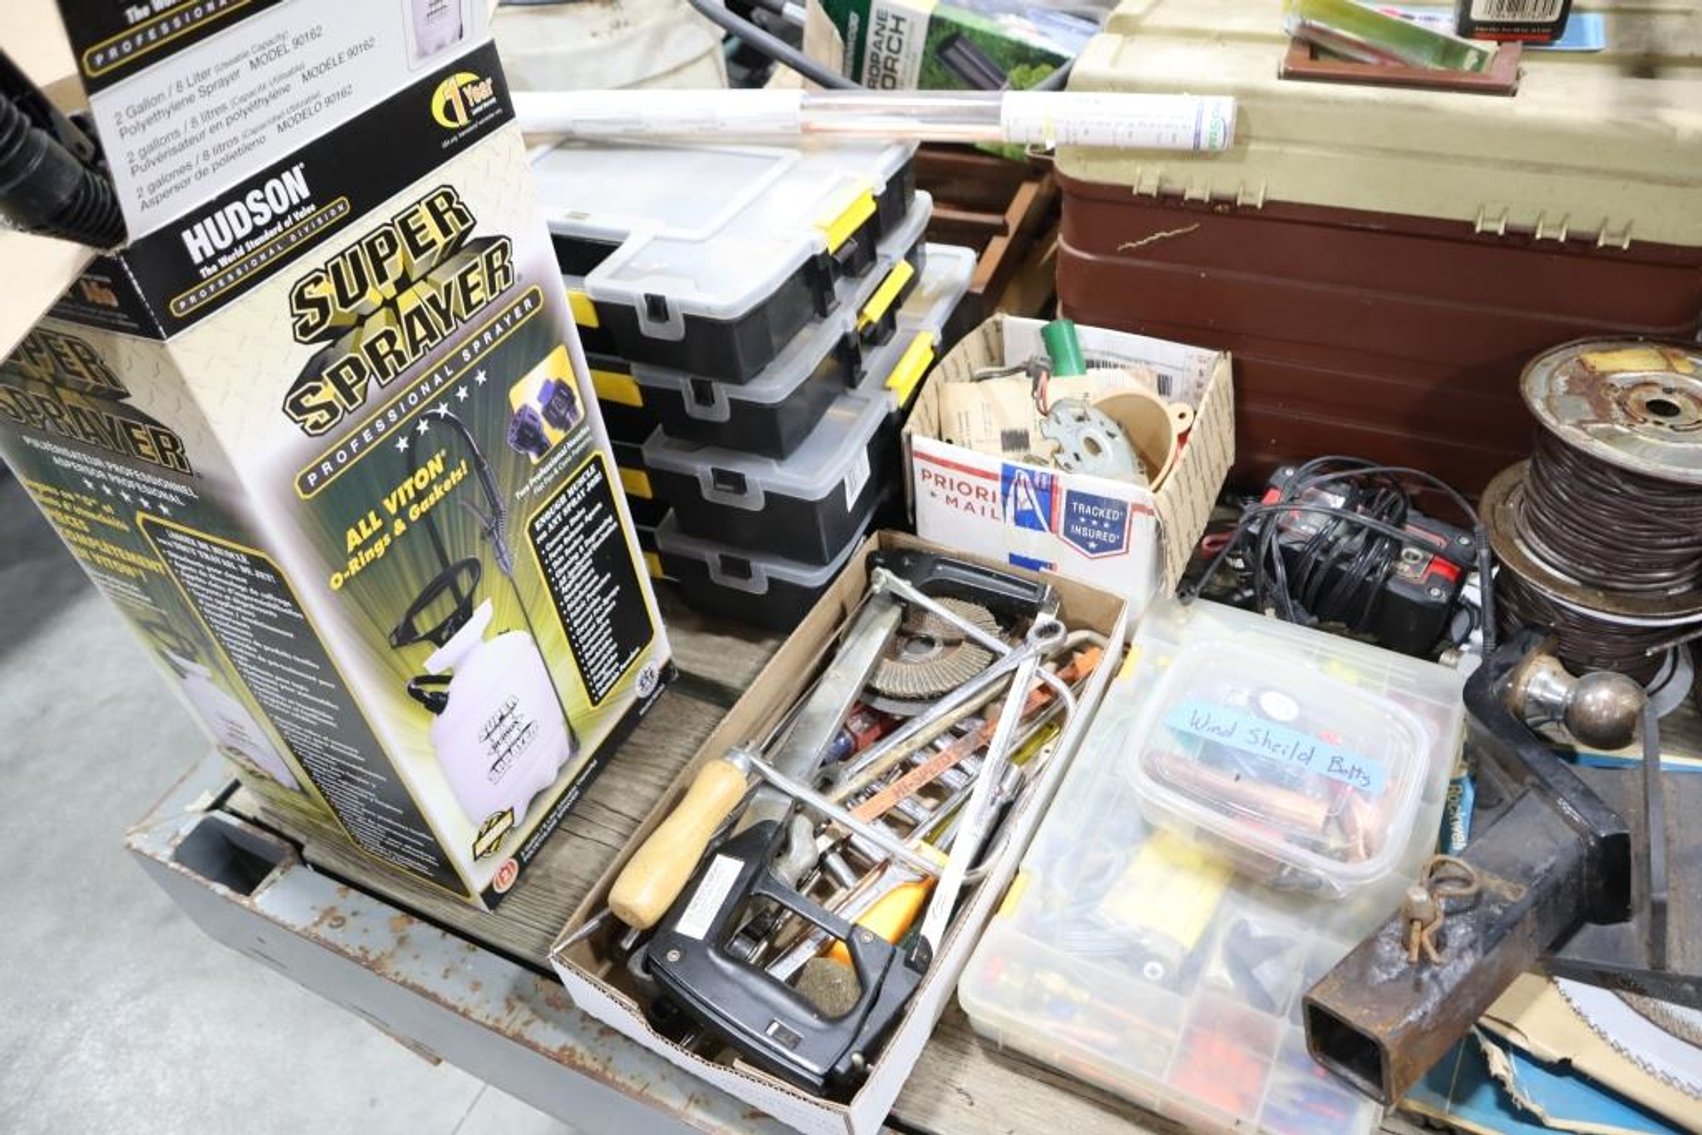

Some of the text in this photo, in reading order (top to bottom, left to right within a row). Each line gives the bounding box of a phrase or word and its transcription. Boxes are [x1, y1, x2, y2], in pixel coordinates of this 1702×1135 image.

[95, 0, 237, 66] PROFESSIONA
[125, 4, 150, 24] The
[119, 24, 324, 138] Polyethylene Sprayer MODEL 90162
[867, 8, 889, 90] ROPANE
[881, 14, 907, 91] ORCH
[114, 110, 122, 125] 2
[125, 92, 165, 119] Gallon
[186, 68, 213, 89] Liter
[462, 77, 494, 107] Year
[126, 150, 135, 164] 2
[138, 130, 180, 161] gallons
[200, 103, 229, 121] litres
[140, 178, 192, 212] Aspersor
[194, 166, 209, 181] de
[277, 101, 323, 134] MODELO
[208, 120, 224, 135] en
[136, 186, 145, 199] 2
[147, 163, 194, 196] galones
[212, 136, 240, 157] litros
[181, 165, 311, 265] HUDSON
[199, 203, 317, 280] The World Standard of Value
[179, 243, 284, 309] PROFESSIONAL
[290, 203, 346, 242] DIVISION
[290, 185, 476, 344] SUPER
[282, 238, 515, 436] SPRAYER
[307, 298, 534, 487] PROFESSIONAL SPRAYER
[347, 453, 444, 555] ALL VITON
[534, 493, 569, 532] ENOUGH
[920, 468, 997, 503] PRIORI
[945, 495, 1002, 521] MAIL
[1072, 501, 1120, 521] TRACKED
[330, 533, 392, 591] O-Rings
[393, 518, 407, 537] &
[408, 459, 468, 522] Gaskets!
[1070, 523, 1119, 544] INSURED
[1190, 709, 1237, 738] Wind
[1246, 728, 1317, 767] Sheild
